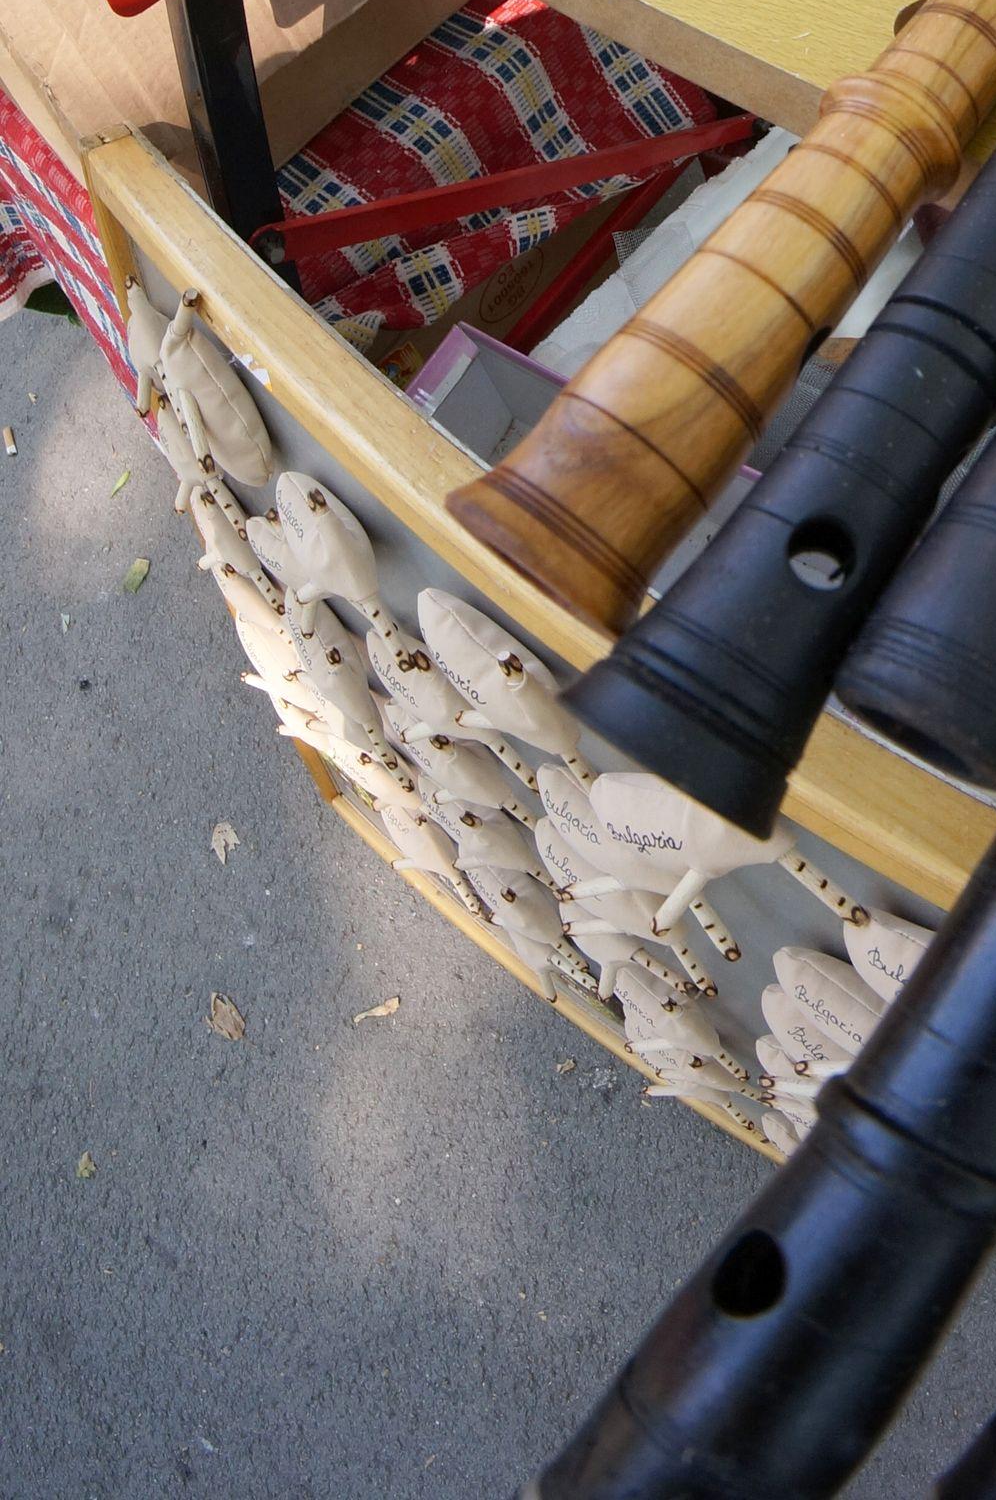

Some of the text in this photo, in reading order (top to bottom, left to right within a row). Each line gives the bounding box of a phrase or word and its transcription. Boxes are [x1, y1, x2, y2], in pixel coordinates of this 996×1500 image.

[544, 789, 601, 845] Bulgaria
[606, 822, 683, 855] Bulgaria
[614, 985, 657, 1029] ulgaria
[794, 984, 865, 1046] Bulgaria
